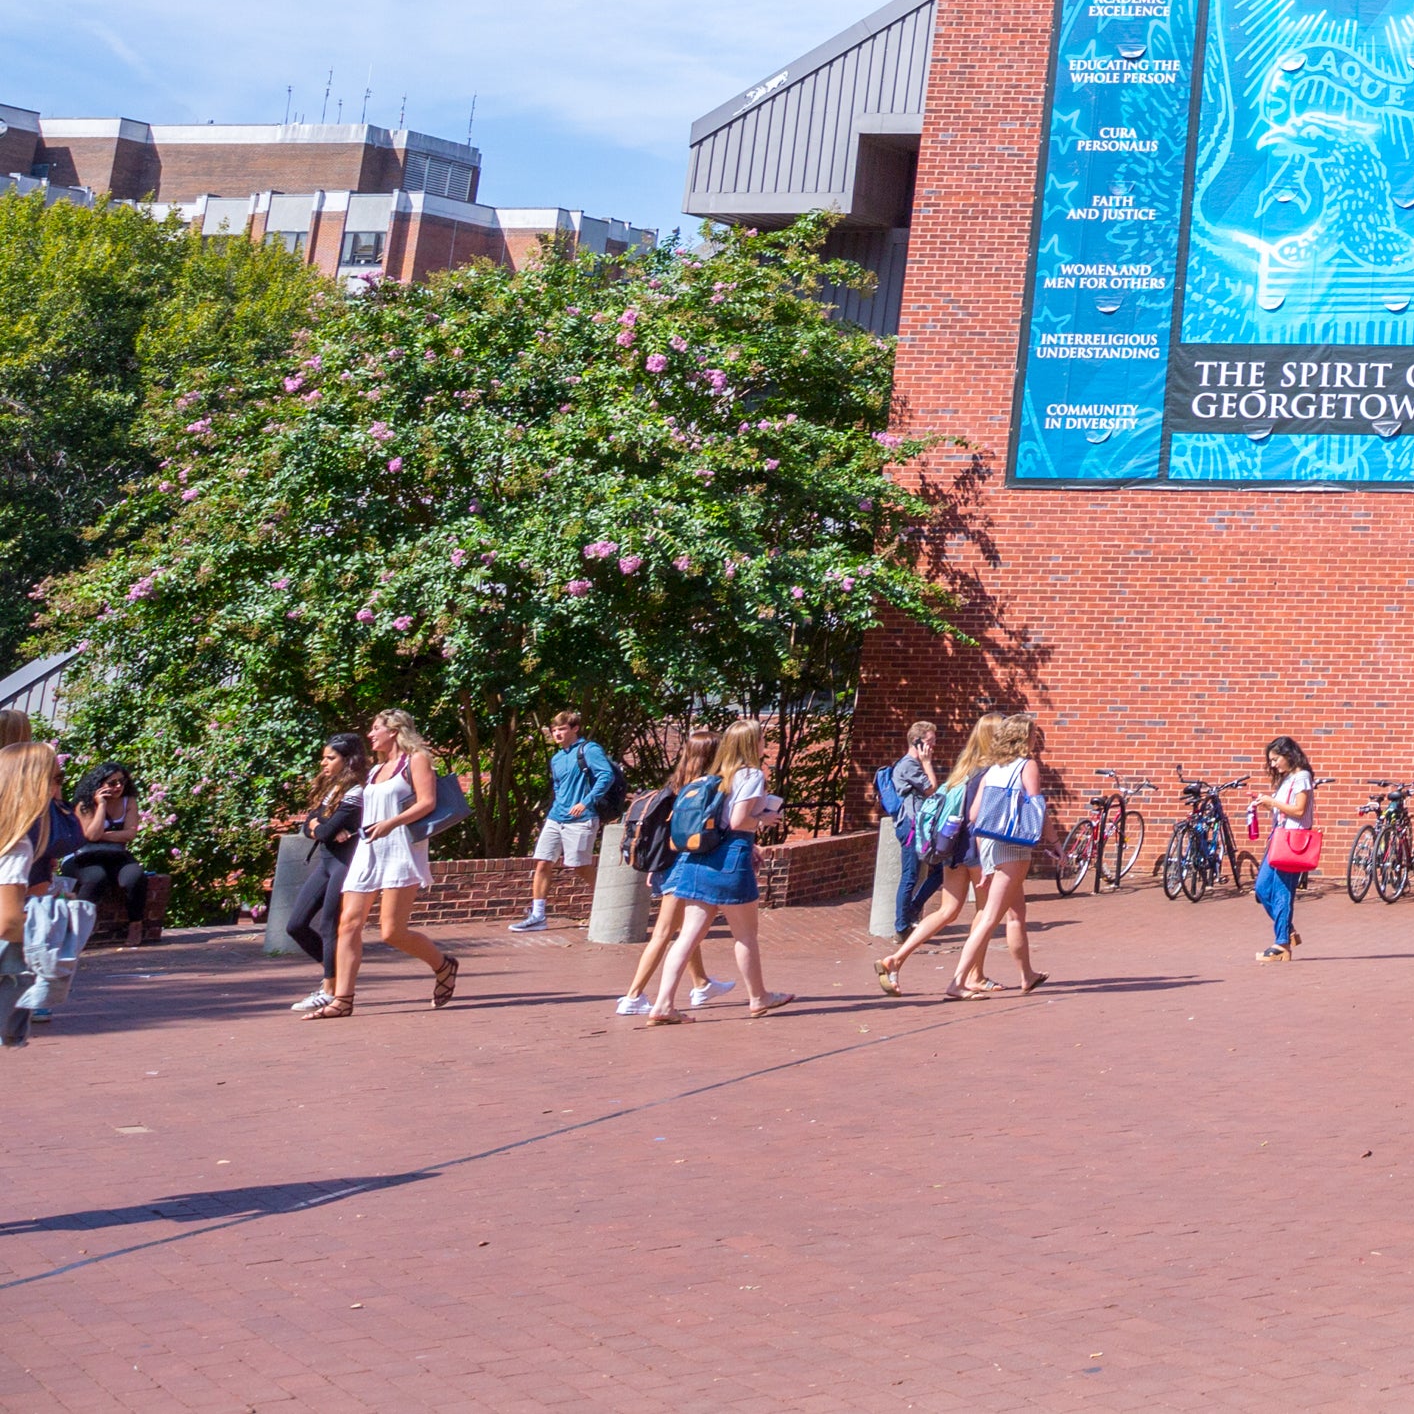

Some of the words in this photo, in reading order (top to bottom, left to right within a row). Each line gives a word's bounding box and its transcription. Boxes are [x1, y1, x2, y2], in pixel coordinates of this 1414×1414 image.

[1088, 5, 1170, 17] EXCELLENCE
[1068, 59, 1149, 71] EDUCATING
[1154, 60, 1181, 71] THE
[1070, 72, 1120, 83] WHOLE
[1122, 72, 1177, 84] PERSON
[1099, 127, 1138, 139] CURA
[1076, 140, 1159, 152] PERSONALIS
[1092, 195, 1133, 207] FAITH
[1066, 208, 1099, 220] AND
[1101, 208, 1157, 223] JUSTICE
[1060, 263, 1117, 276] WOMEN
[1119, 264, 1153, 276] AND
[1043, 277, 1076, 289] MEN
[1078, 277, 1108, 289] FOR
[1110, 277, 1166, 289] OTHERS
[1041, 333, 1158, 346] INTERRELIGIOUS
[1036, 346, 1160, 359] UNDERSTANDING
[1194, 360, 1266, 388] THE
[1280, 361, 1393, 389] SPIRIT
[1046, 404, 1140, 417] COMMUNITY
[1044, 417, 1063, 430] IN
[1065, 417, 1140, 430] DIVERSITY
